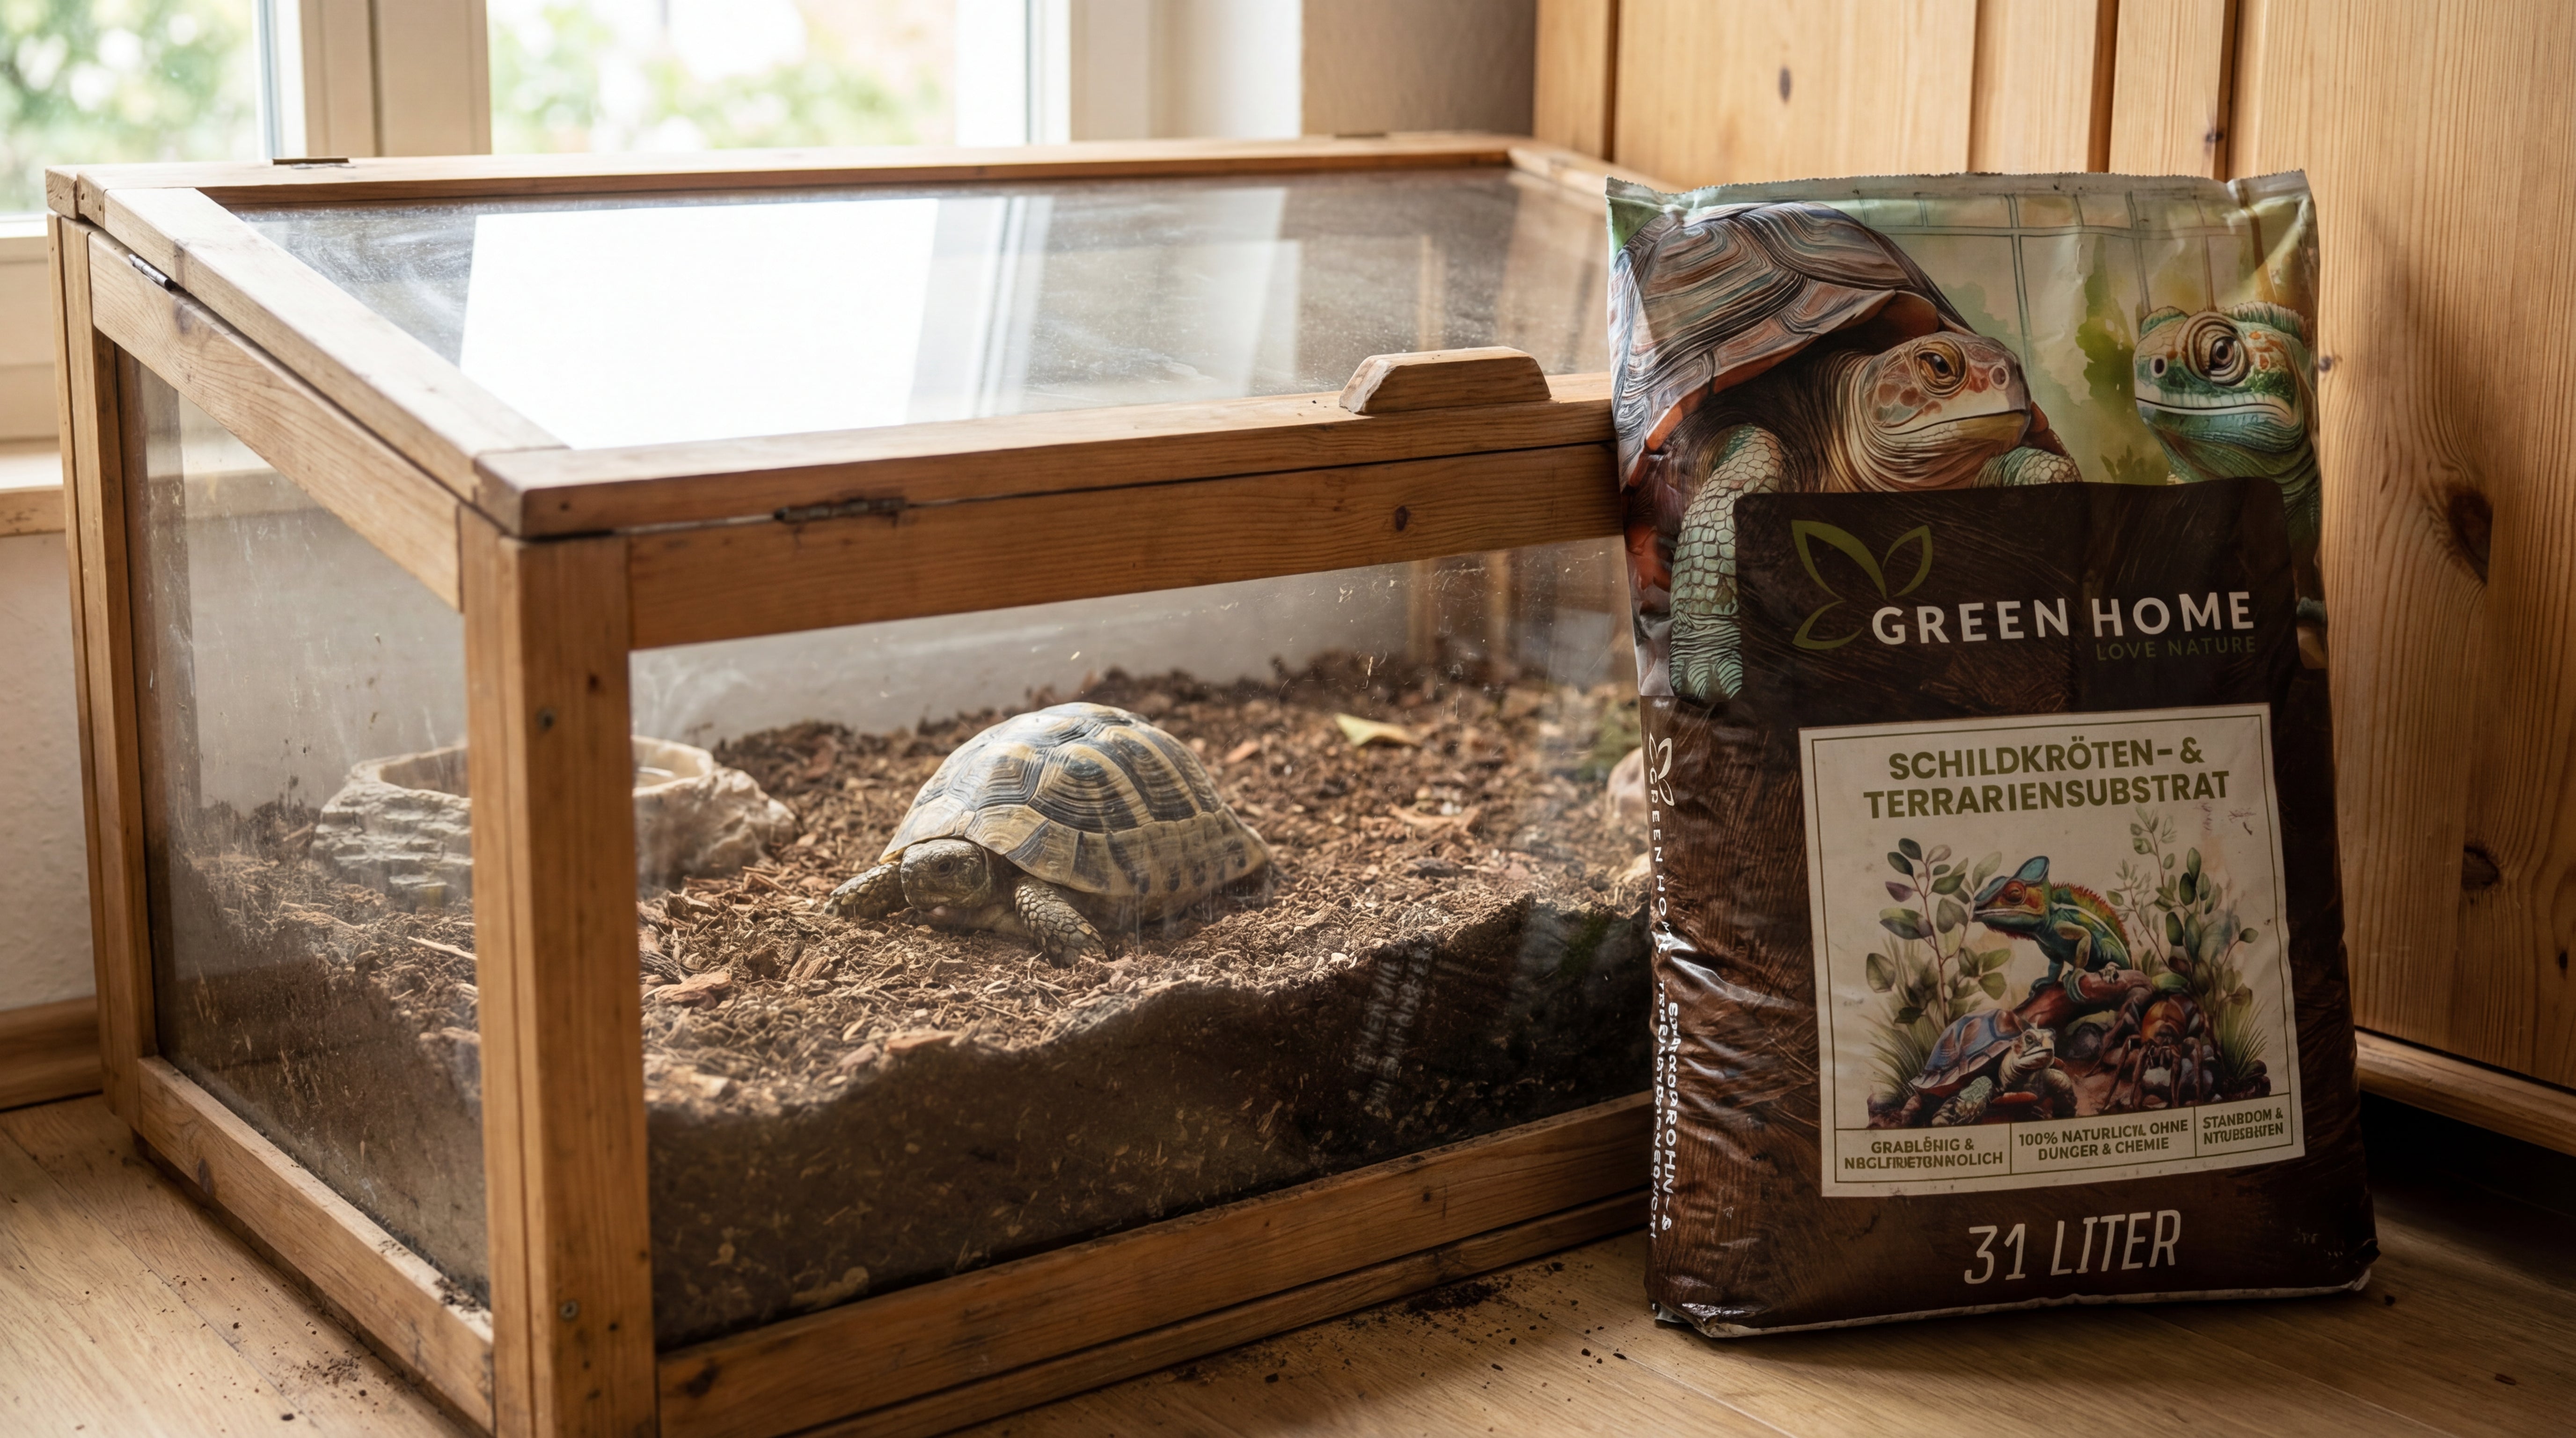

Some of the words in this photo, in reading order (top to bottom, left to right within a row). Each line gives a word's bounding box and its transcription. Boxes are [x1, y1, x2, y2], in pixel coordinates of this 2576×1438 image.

[1872, 598, 2069, 646] GREEN
[2092, 590, 2255, 638] HOME
[2096, 640, 2157, 662] LOVE
[2168, 636, 2256, 657] NATURE
[1888, 736, 2173, 781] SCHILDKRÖTEN-
[2179, 736, 2206, 765] &
[1649, 766, 1663, 863] GREEN
[1863, 770, 2230, 820] TERRARIENSUBSTRAT
[1964, 1138, 1975, 1151] &
[2019, 1131, 2058, 1147] 100%
[2150, 1119, 2188, 1135] OHNE
[2101, 1143, 2112, 1155] &
[2115, 1137, 2170, 1154] CHEMIE
[1964, 1223, 2027, 1285] 31
[2049, 1208, 2182, 1277] LITER
